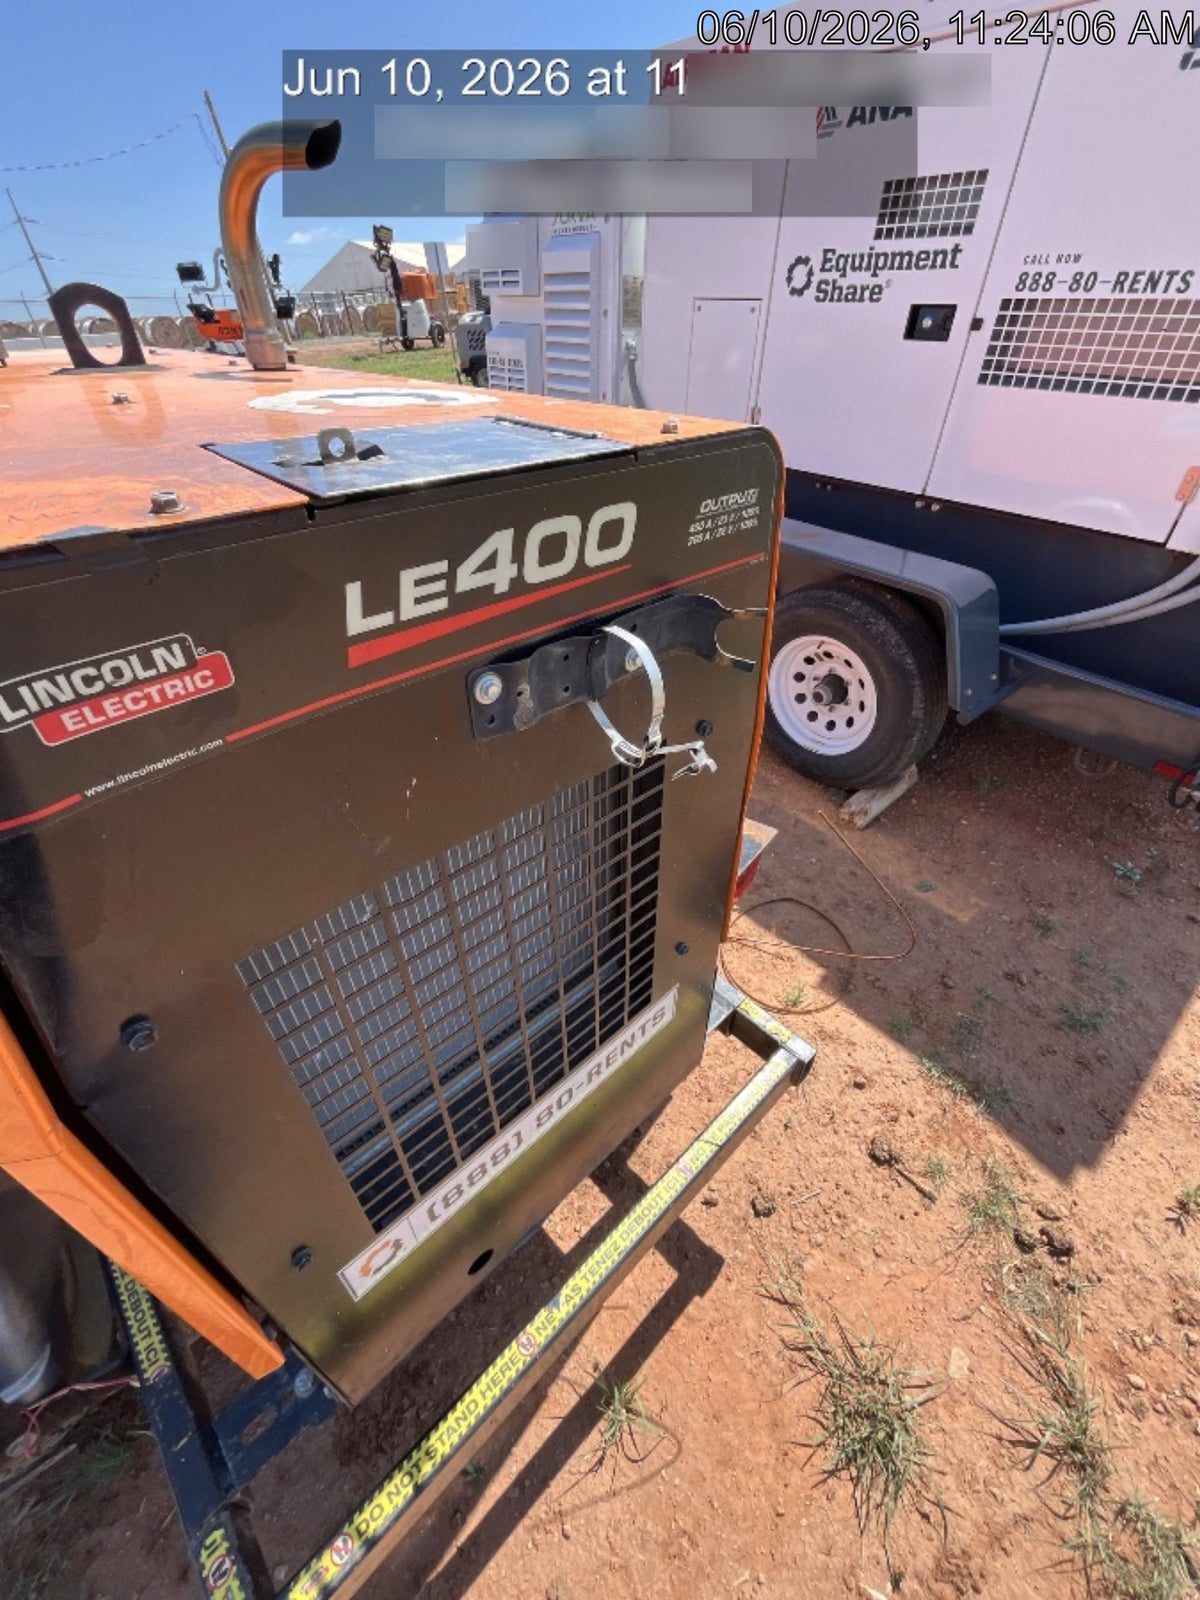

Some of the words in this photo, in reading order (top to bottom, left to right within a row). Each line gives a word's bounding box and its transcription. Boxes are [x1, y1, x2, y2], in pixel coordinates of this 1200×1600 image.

[814, 279, 884, 303] Share
[819, 243, 963, 278] Equipment
[1014, 269, 1196, 294] 888-80-RENTS
[1023, 254, 1050, 266] CALL
[1056, 253, 1083, 264] NOW
[344, 501, 638, 637] LE400
[0, 642, 187, 723] LINCOLN
[60, 669, 215, 733] ELECTRIC
[84, 737, 223, 798] www.lincolnelectric.com
[427, 1130, 524, 1223] (888)
[535, 1005, 667, 1130] 80-RENTS
[534, 1311, 556, 1337] NE
[580, 1240, 621, 1284] TENEZ
[619, 1193, 665, 1242] DEBOUT
[123, 1280, 152, 1341] DEBOUT
[144, 1343, 160, 1367] ICI
[354, 1504, 385, 1538] DO
[386, 1457, 422, 1504] NOT
[424, 1399, 479, 1460] STAND
[479, 1352, 521, 1400] HERE
